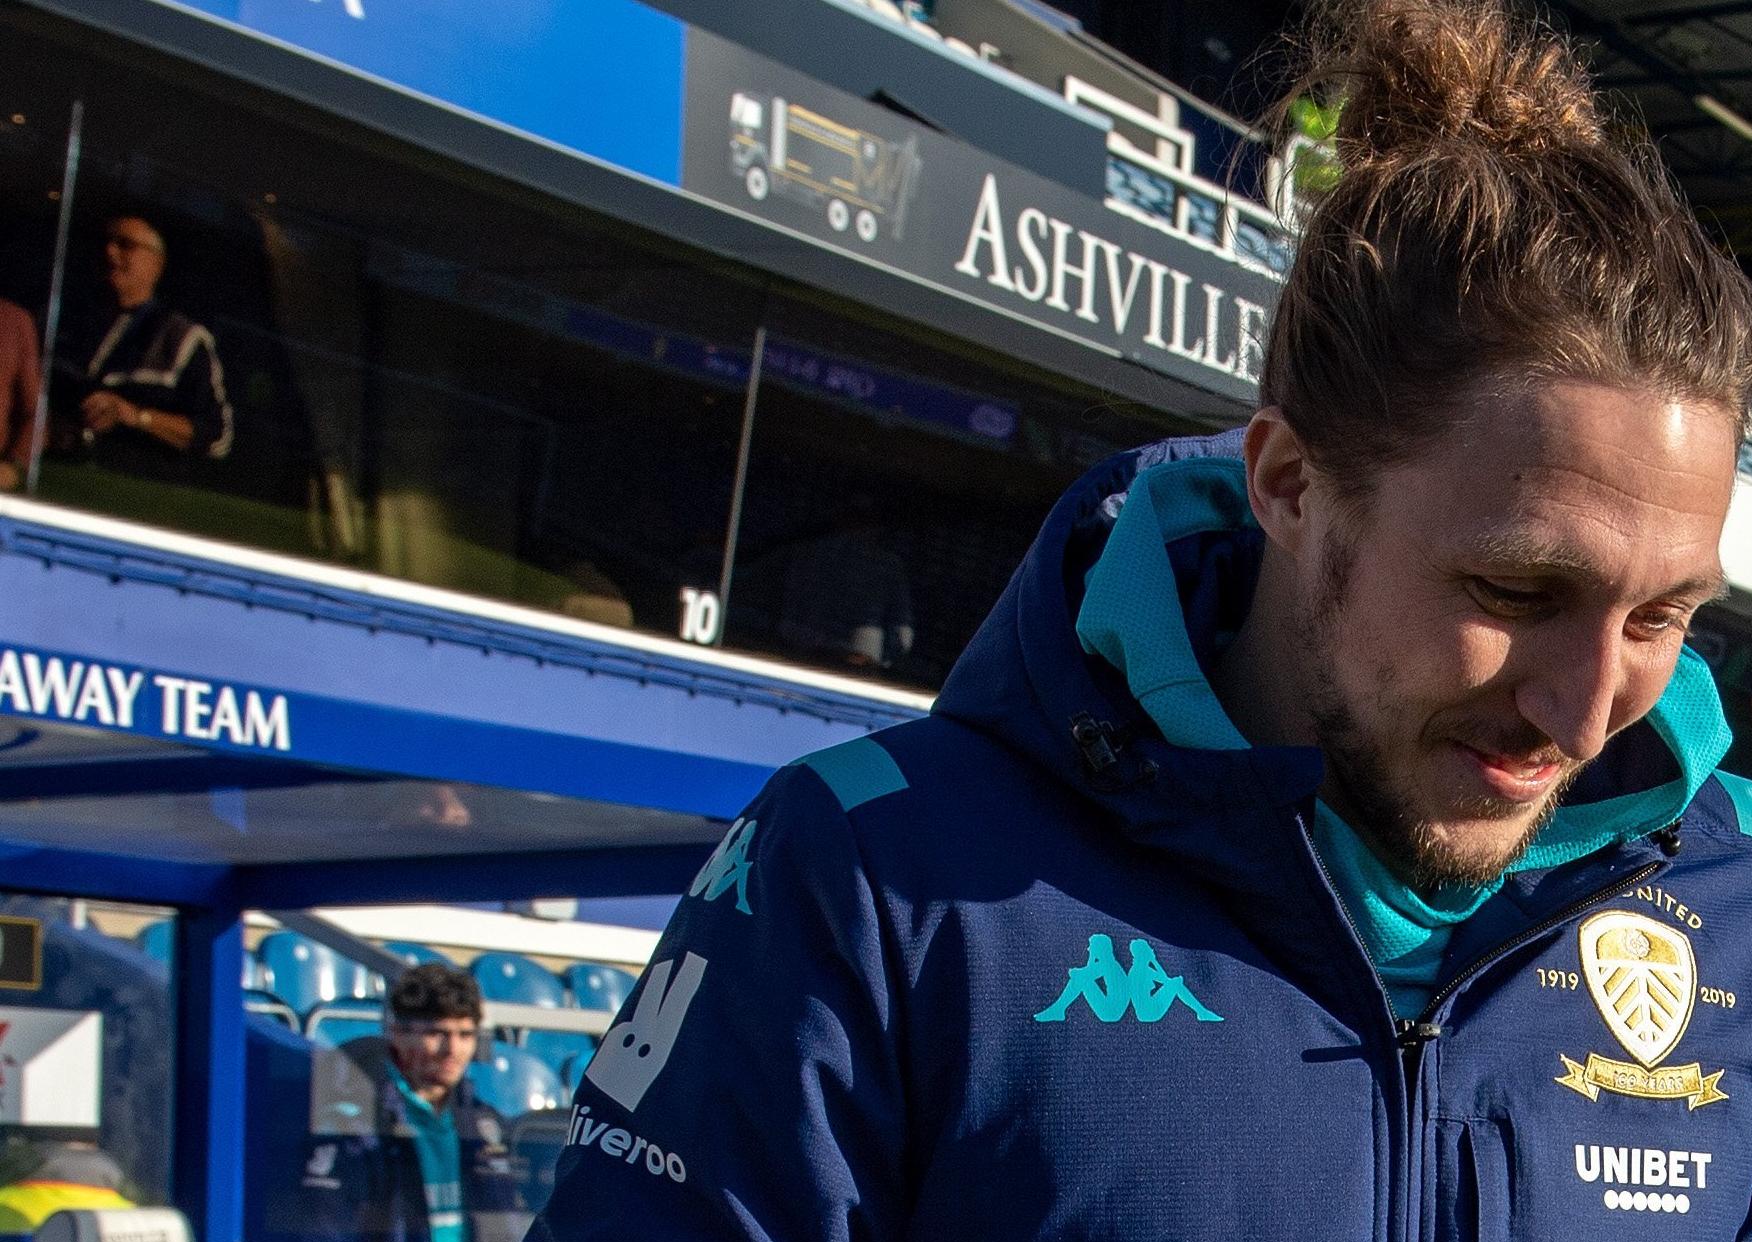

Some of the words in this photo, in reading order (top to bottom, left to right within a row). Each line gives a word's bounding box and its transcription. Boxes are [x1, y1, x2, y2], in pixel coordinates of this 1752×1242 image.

[954, 173, 1266, 385] ASHVILLE
[681, 587, 720, 644] 10
[0, 650, 143, 728] AWAY
[154, 675, 291, 751] TEAM
[1622, 885, 1704, 930] NITED
[1537, 968, 1580, 991] 1919
[1700, 987, 1737, 1010] 2019
[1575, 1144, 1712, 1189] UNIBET
